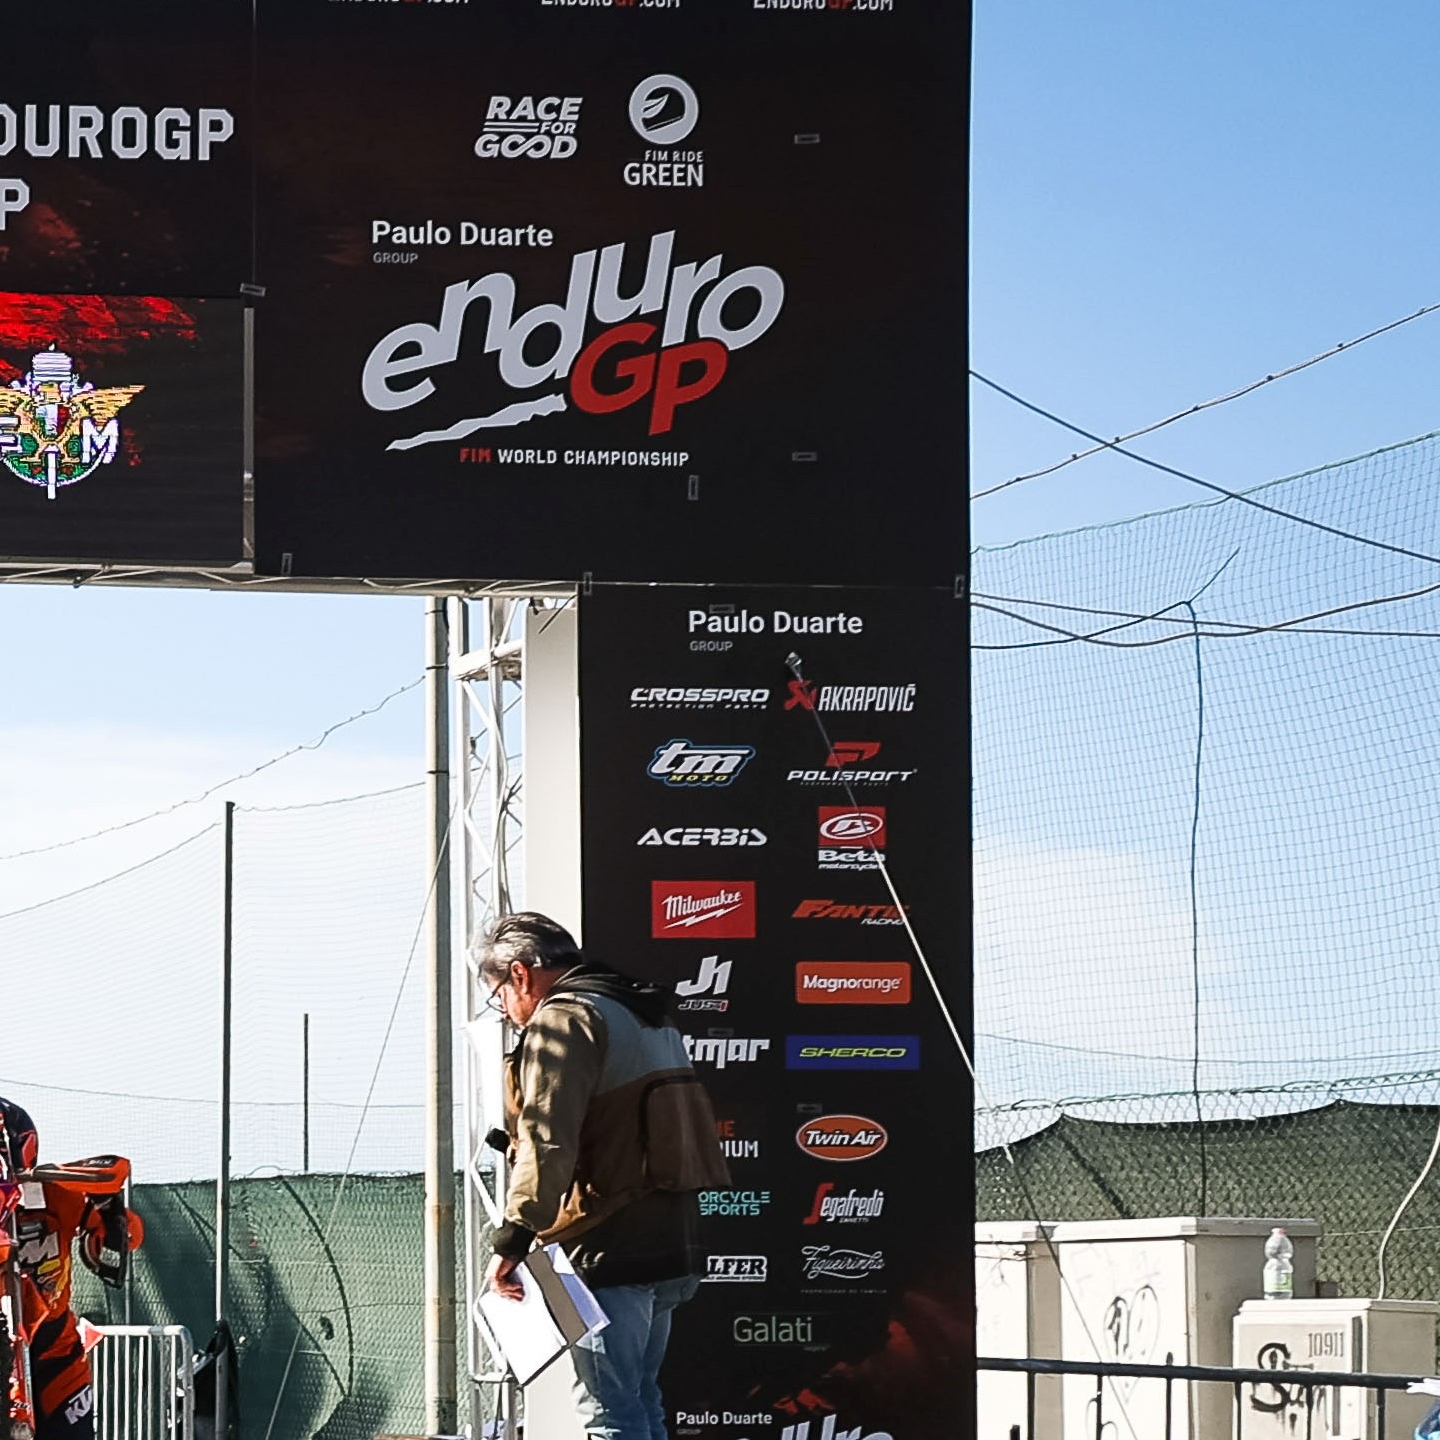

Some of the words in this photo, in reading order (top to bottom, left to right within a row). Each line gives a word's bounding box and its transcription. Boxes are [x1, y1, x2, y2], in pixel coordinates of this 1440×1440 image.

[486, 96, 583, 120] RACE
[540, 122, 576, 134] FOR
[474, 134, 577, 158] GOOD
[645, 150, 668, 162] FIM
[673, 151, 703, 162] RIDE
[624, 163, 703, 187] GREEN
[372, 220, 451, 245] Paulo
[460, 222, 553, 247] Duarte
[373, 252, 418, 264] GROUP
[362, 230, 784, 411] enduro
[569, 322, 728, 435] GP
[460, 448, 491, 463] FIM
[498, 449, 557, 465] WORLD
[564, 451, 689, 467] CHAMPIONSHIP
[689, 610, 764, 633] Paulo
[774, 611, 863, 634] Duarte
[690, 640, 733, 651] GROUP
[630, 687, 770, 703] CROSSPRO
[787, 770, 913, 782] POLISPORT
[637, 827, 767, 846] ACERBIS
[818, 850, 886, 862] Beta
[818, 863, 884, 871] motorcycle
[661, 890, 743, 920] Milwaukee
[803, 974, 900, 993] Magnorange
[683, 1035, 770, 1068] tmar
[799, 1047, 906, 1058] SHERCO
[806, 1131, 850, 1146] Twin
[852, 1131, 880, 1146] Air
[698, 1191, 771, 1203] ORCYCLE
[802, 1183, 885, 1224] Segafredo
[700, 1204, 760, 1216] SPORTS
[708, 1257, 767, 1276] LFER
[734, 1316, 812, 1342] Galati
[1307, 1331, 1345, 1358] 10911
[676, 1411, 719, 1425] Paulo
[723, 1412, 772, 1425] Duarte
